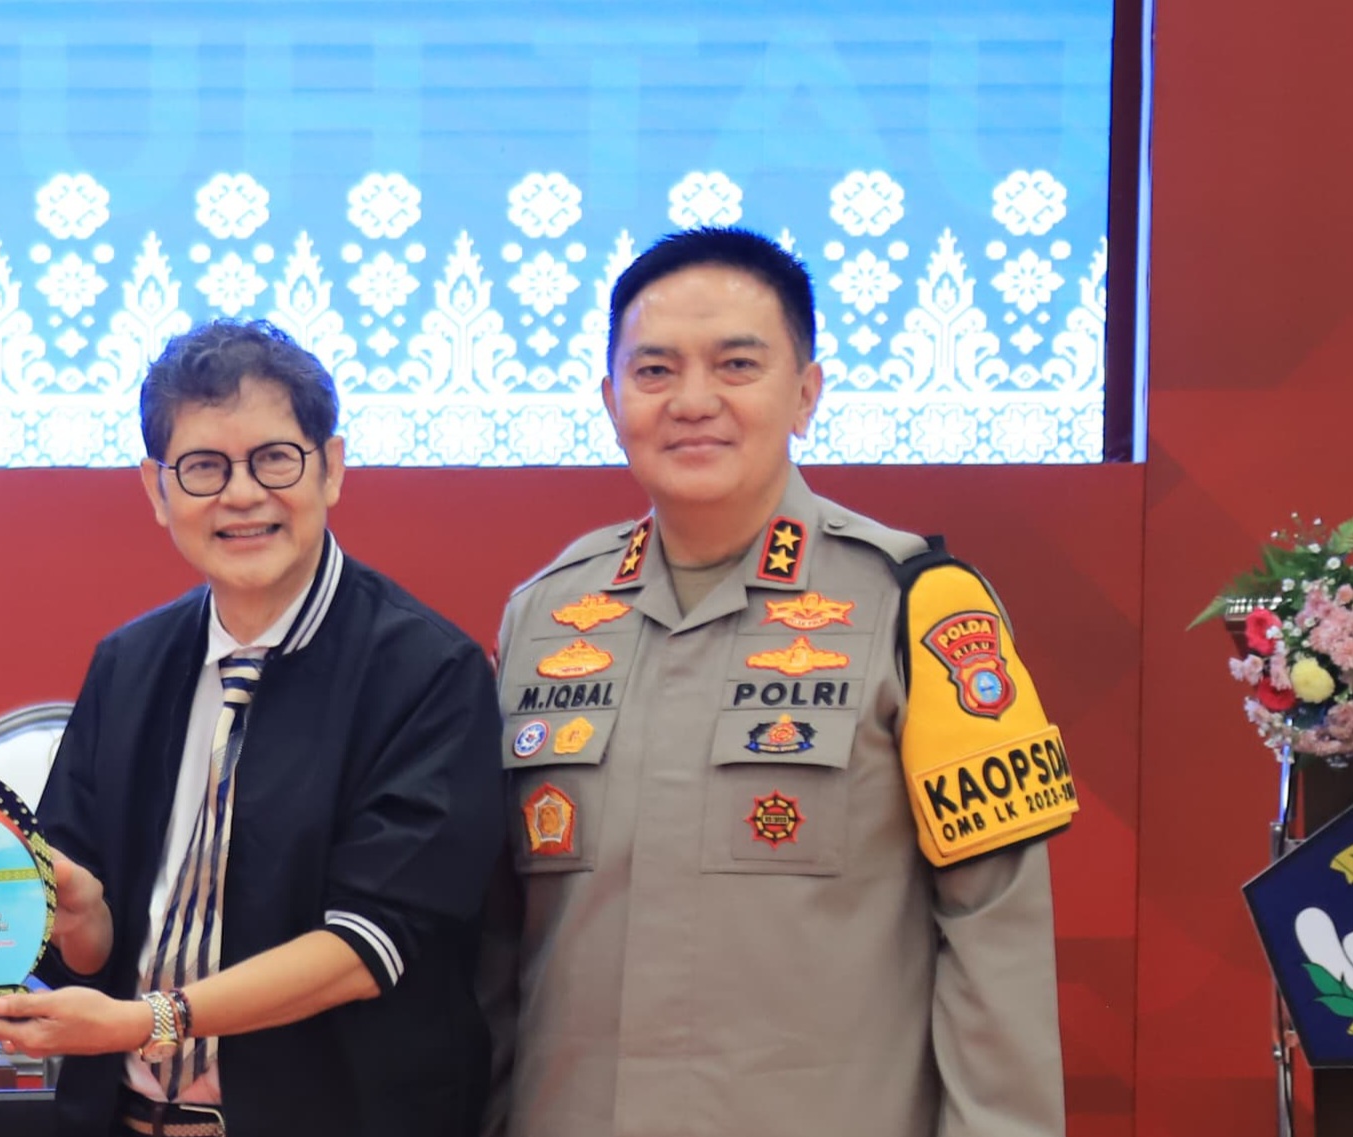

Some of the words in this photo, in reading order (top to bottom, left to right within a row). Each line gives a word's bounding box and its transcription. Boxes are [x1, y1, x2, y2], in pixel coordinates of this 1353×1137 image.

[532, 26, 1109, 216] TAU
[937, 619, 993, 649] POLDA
[952, 641, 991, 660] RIAU
[517, 683, 614, 711] M.IQBAL
[733, 682, 851, 707] POLRI
[942, 811, 987, 842] OMB
[994, 800, 1019, 824] LK
